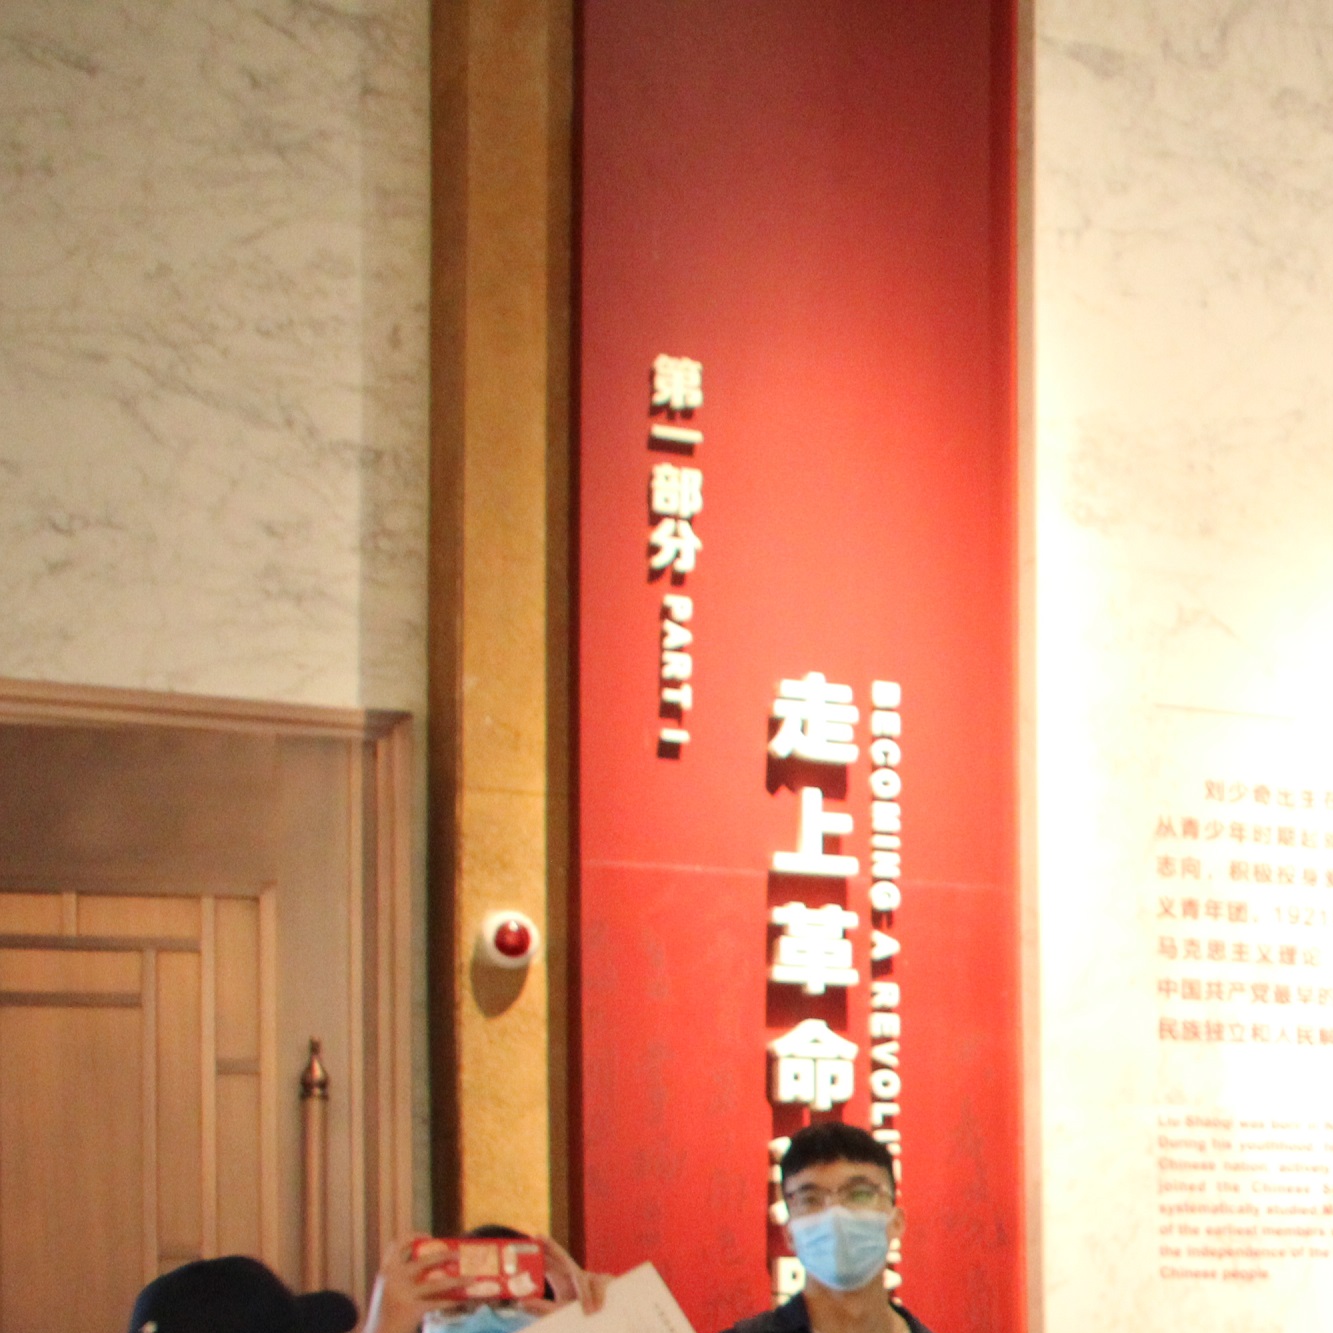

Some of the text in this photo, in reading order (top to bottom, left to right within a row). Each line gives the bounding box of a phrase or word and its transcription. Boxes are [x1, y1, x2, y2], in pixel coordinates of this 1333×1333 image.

[650, 355, 703, 573] 第一部分
[661, 595, 693, 710] PART
[870, 680, 902, 912] BECOMING
[770, 671, 858, 1310] 走上革命
[870, 929, 902, 963] A
